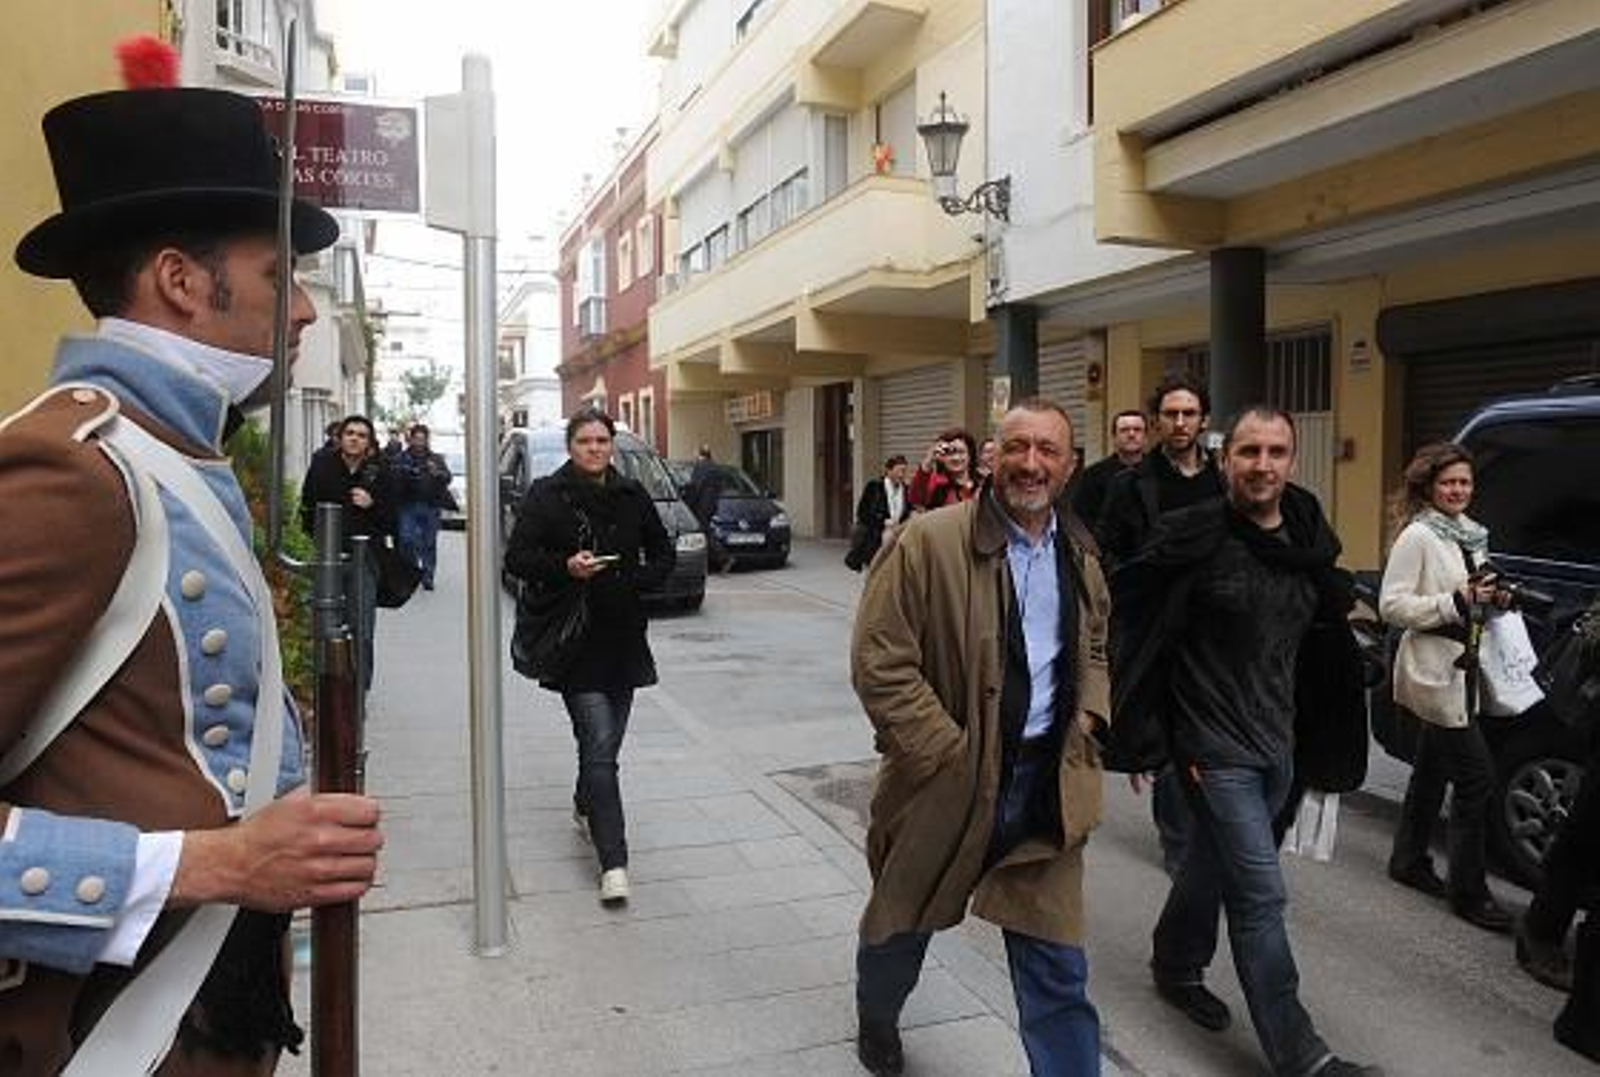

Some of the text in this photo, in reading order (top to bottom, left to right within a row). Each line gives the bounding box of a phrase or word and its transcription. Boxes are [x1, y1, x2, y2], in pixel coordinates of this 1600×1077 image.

[309, 147, 389, 166] TEATRO
[290, 167, 395, 188] AS CORTES
